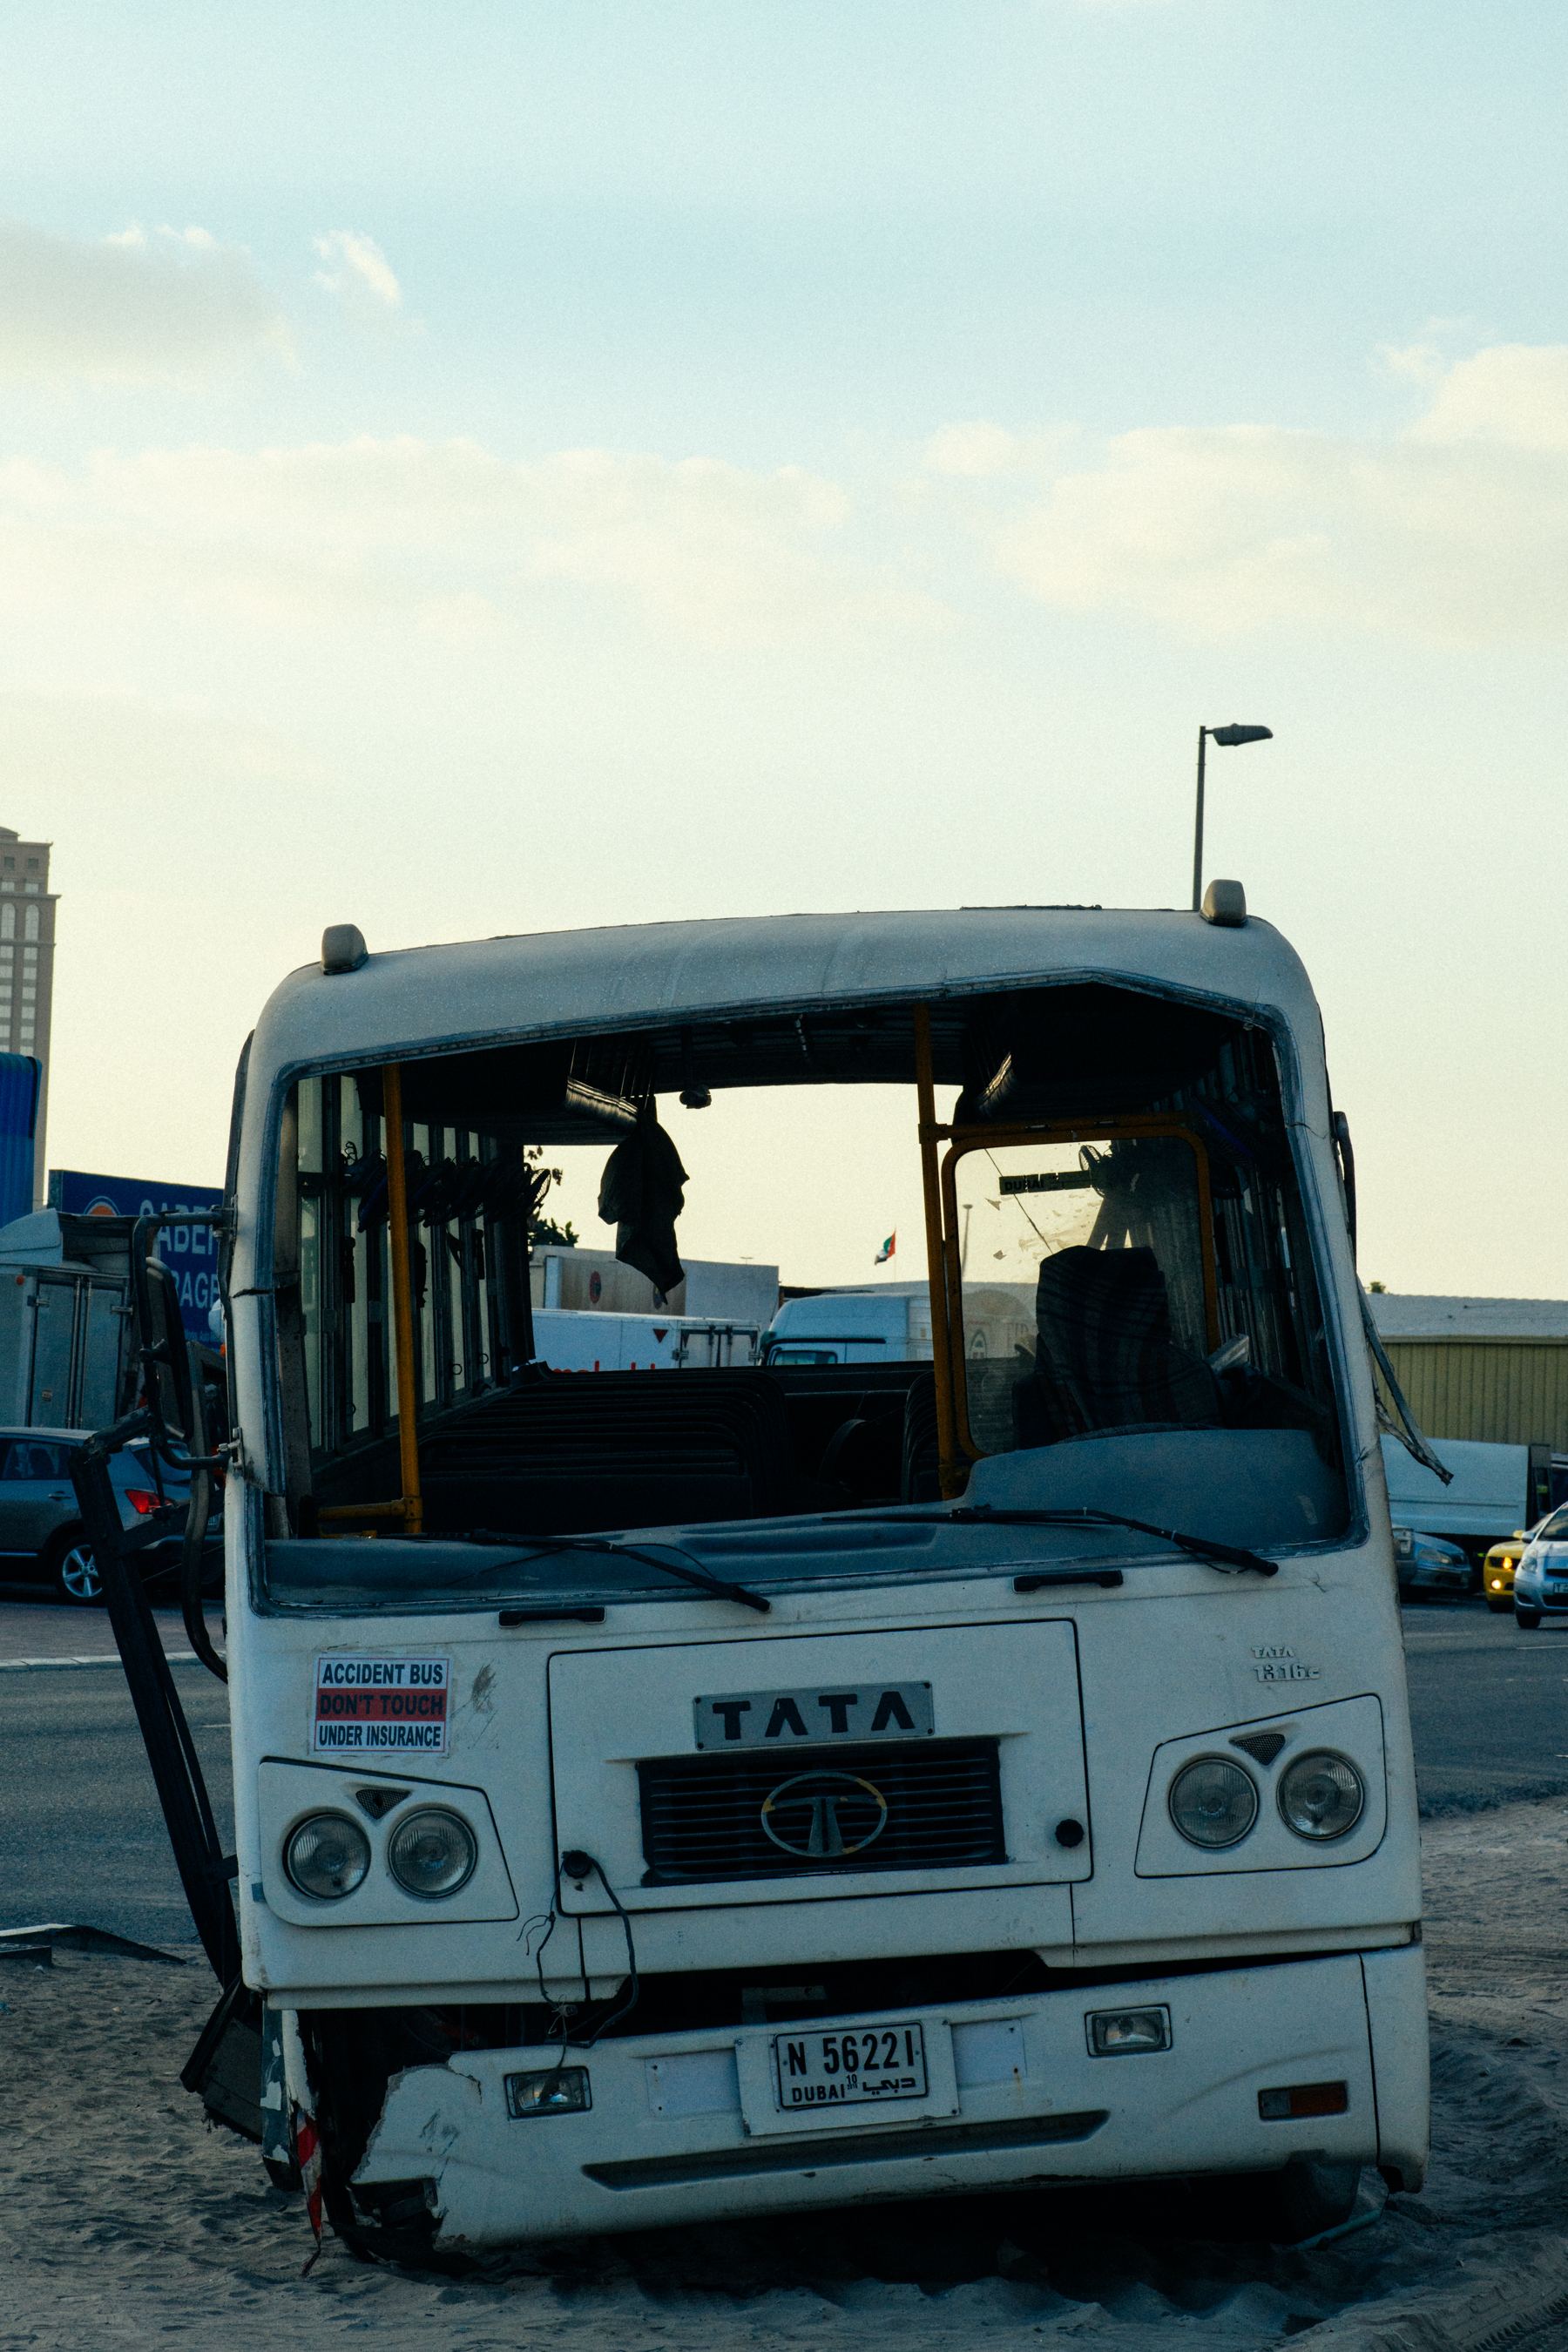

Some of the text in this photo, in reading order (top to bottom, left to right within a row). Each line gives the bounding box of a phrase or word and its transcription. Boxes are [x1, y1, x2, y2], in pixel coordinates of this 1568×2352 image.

[1004, 1179, 1044, 1192] DUBAI
[1251, 1646, 1294, 1659] TATA
[322, 1664, 443, 1684] ACCIDENT BUS
[320, 1694, 443, 1715] DON'T TOUCH
[712, 1691, 915, 1740] TATA
[319, 1726, 442, 1747] UNDER INSURANCE
[787, 2031, 914, 2075] N 56221
[846, 2074, 857, 2085] 10
[862, 2078, 916, 2095] دبي
[792, 2084, 845, 2102] DUBAI
